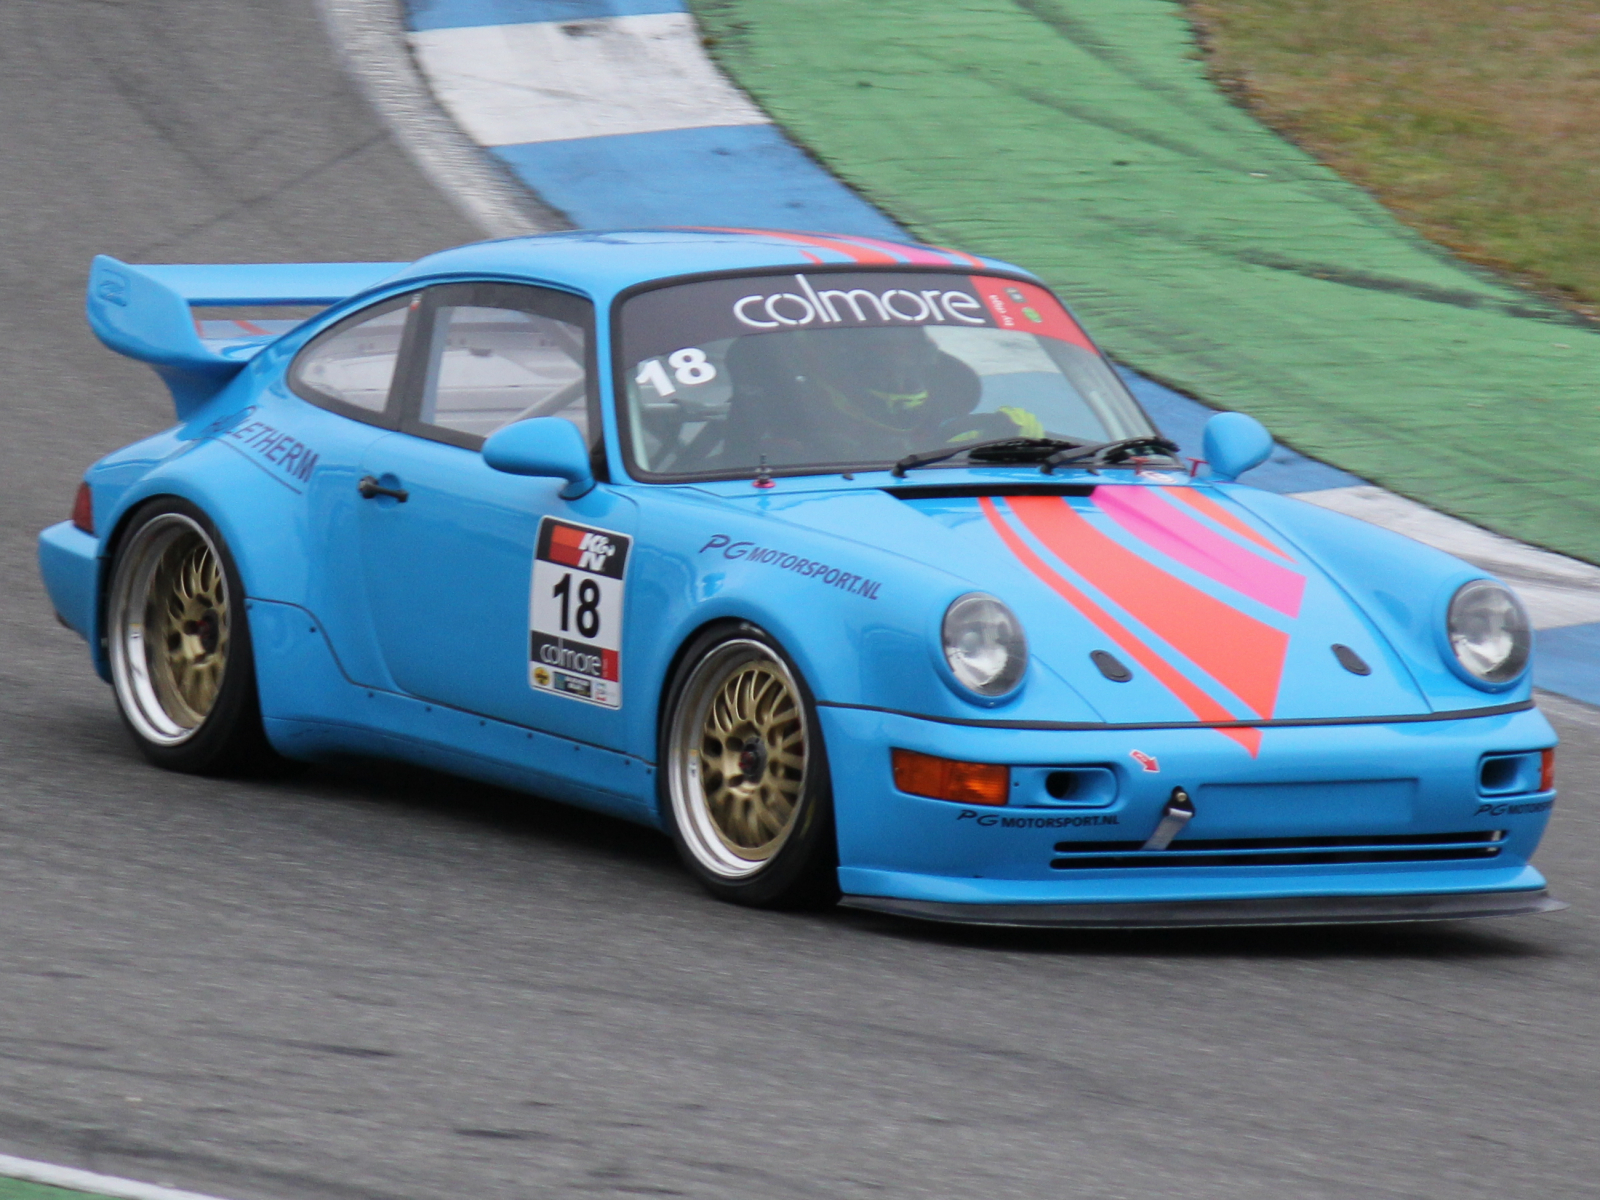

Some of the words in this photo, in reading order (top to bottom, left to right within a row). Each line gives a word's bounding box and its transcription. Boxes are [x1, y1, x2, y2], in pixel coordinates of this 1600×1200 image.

[734, 274, 986, 328] colmore
[635, 347, 717, 397] 18
[553, 573, 601, 639] 18
[540, 637, 602, 676] colmore
